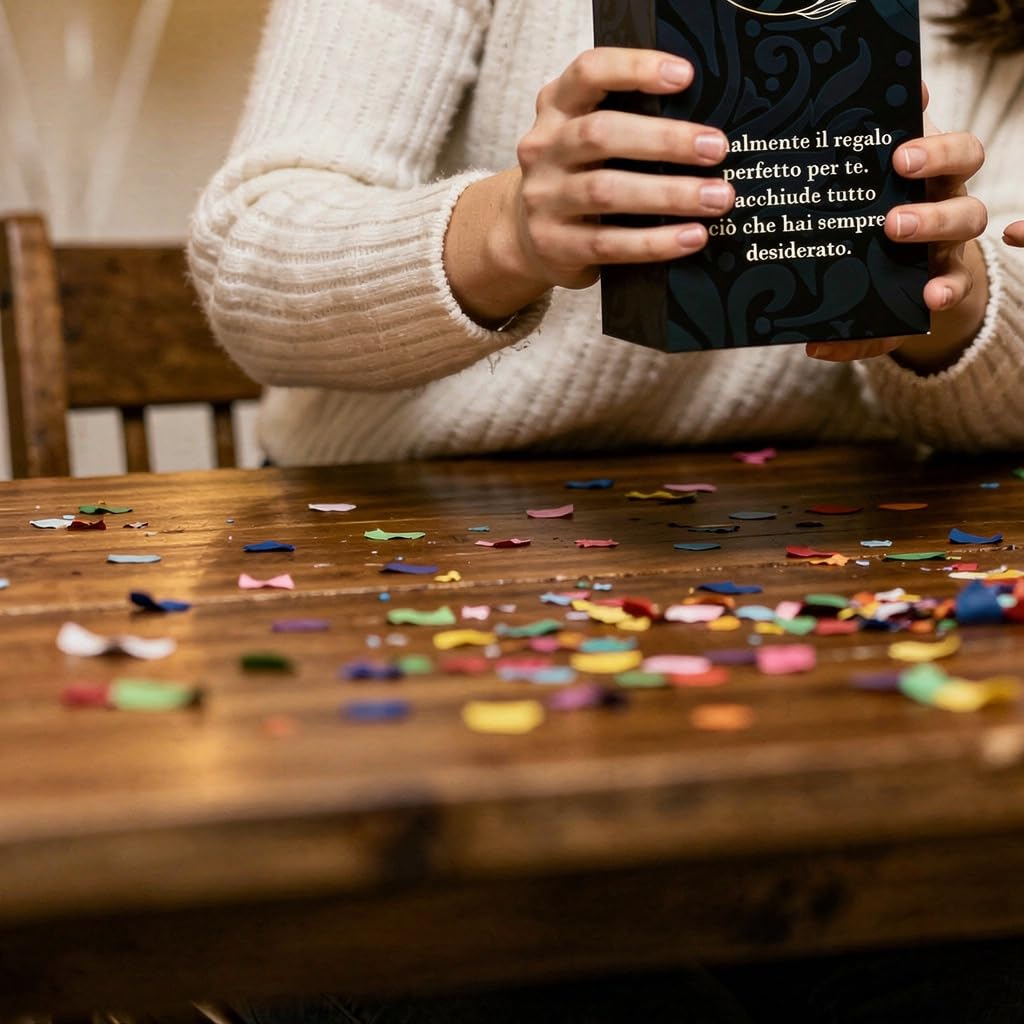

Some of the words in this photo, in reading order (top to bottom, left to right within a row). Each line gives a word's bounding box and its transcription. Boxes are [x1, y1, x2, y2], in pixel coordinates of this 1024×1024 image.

[724, 133, 810, 153] almente
[815, 130, 829, 148] il
[834, 128, 892, 152] regalo
[722, 160, 802, 184] perfetto
[806, 163, 839, 182] per
[845, 160, 869, 175] te.
[735, 187, 822, 208] acchiude
[827, 187, 876, 203] tutto
[708, 218, 737, 237] ciò
[742, 216, 776, 235] che
[781, 213, 813, 233] hai
[818, 213, 885, 234] sempre
[746, 240, 852, 262] desiderato.
